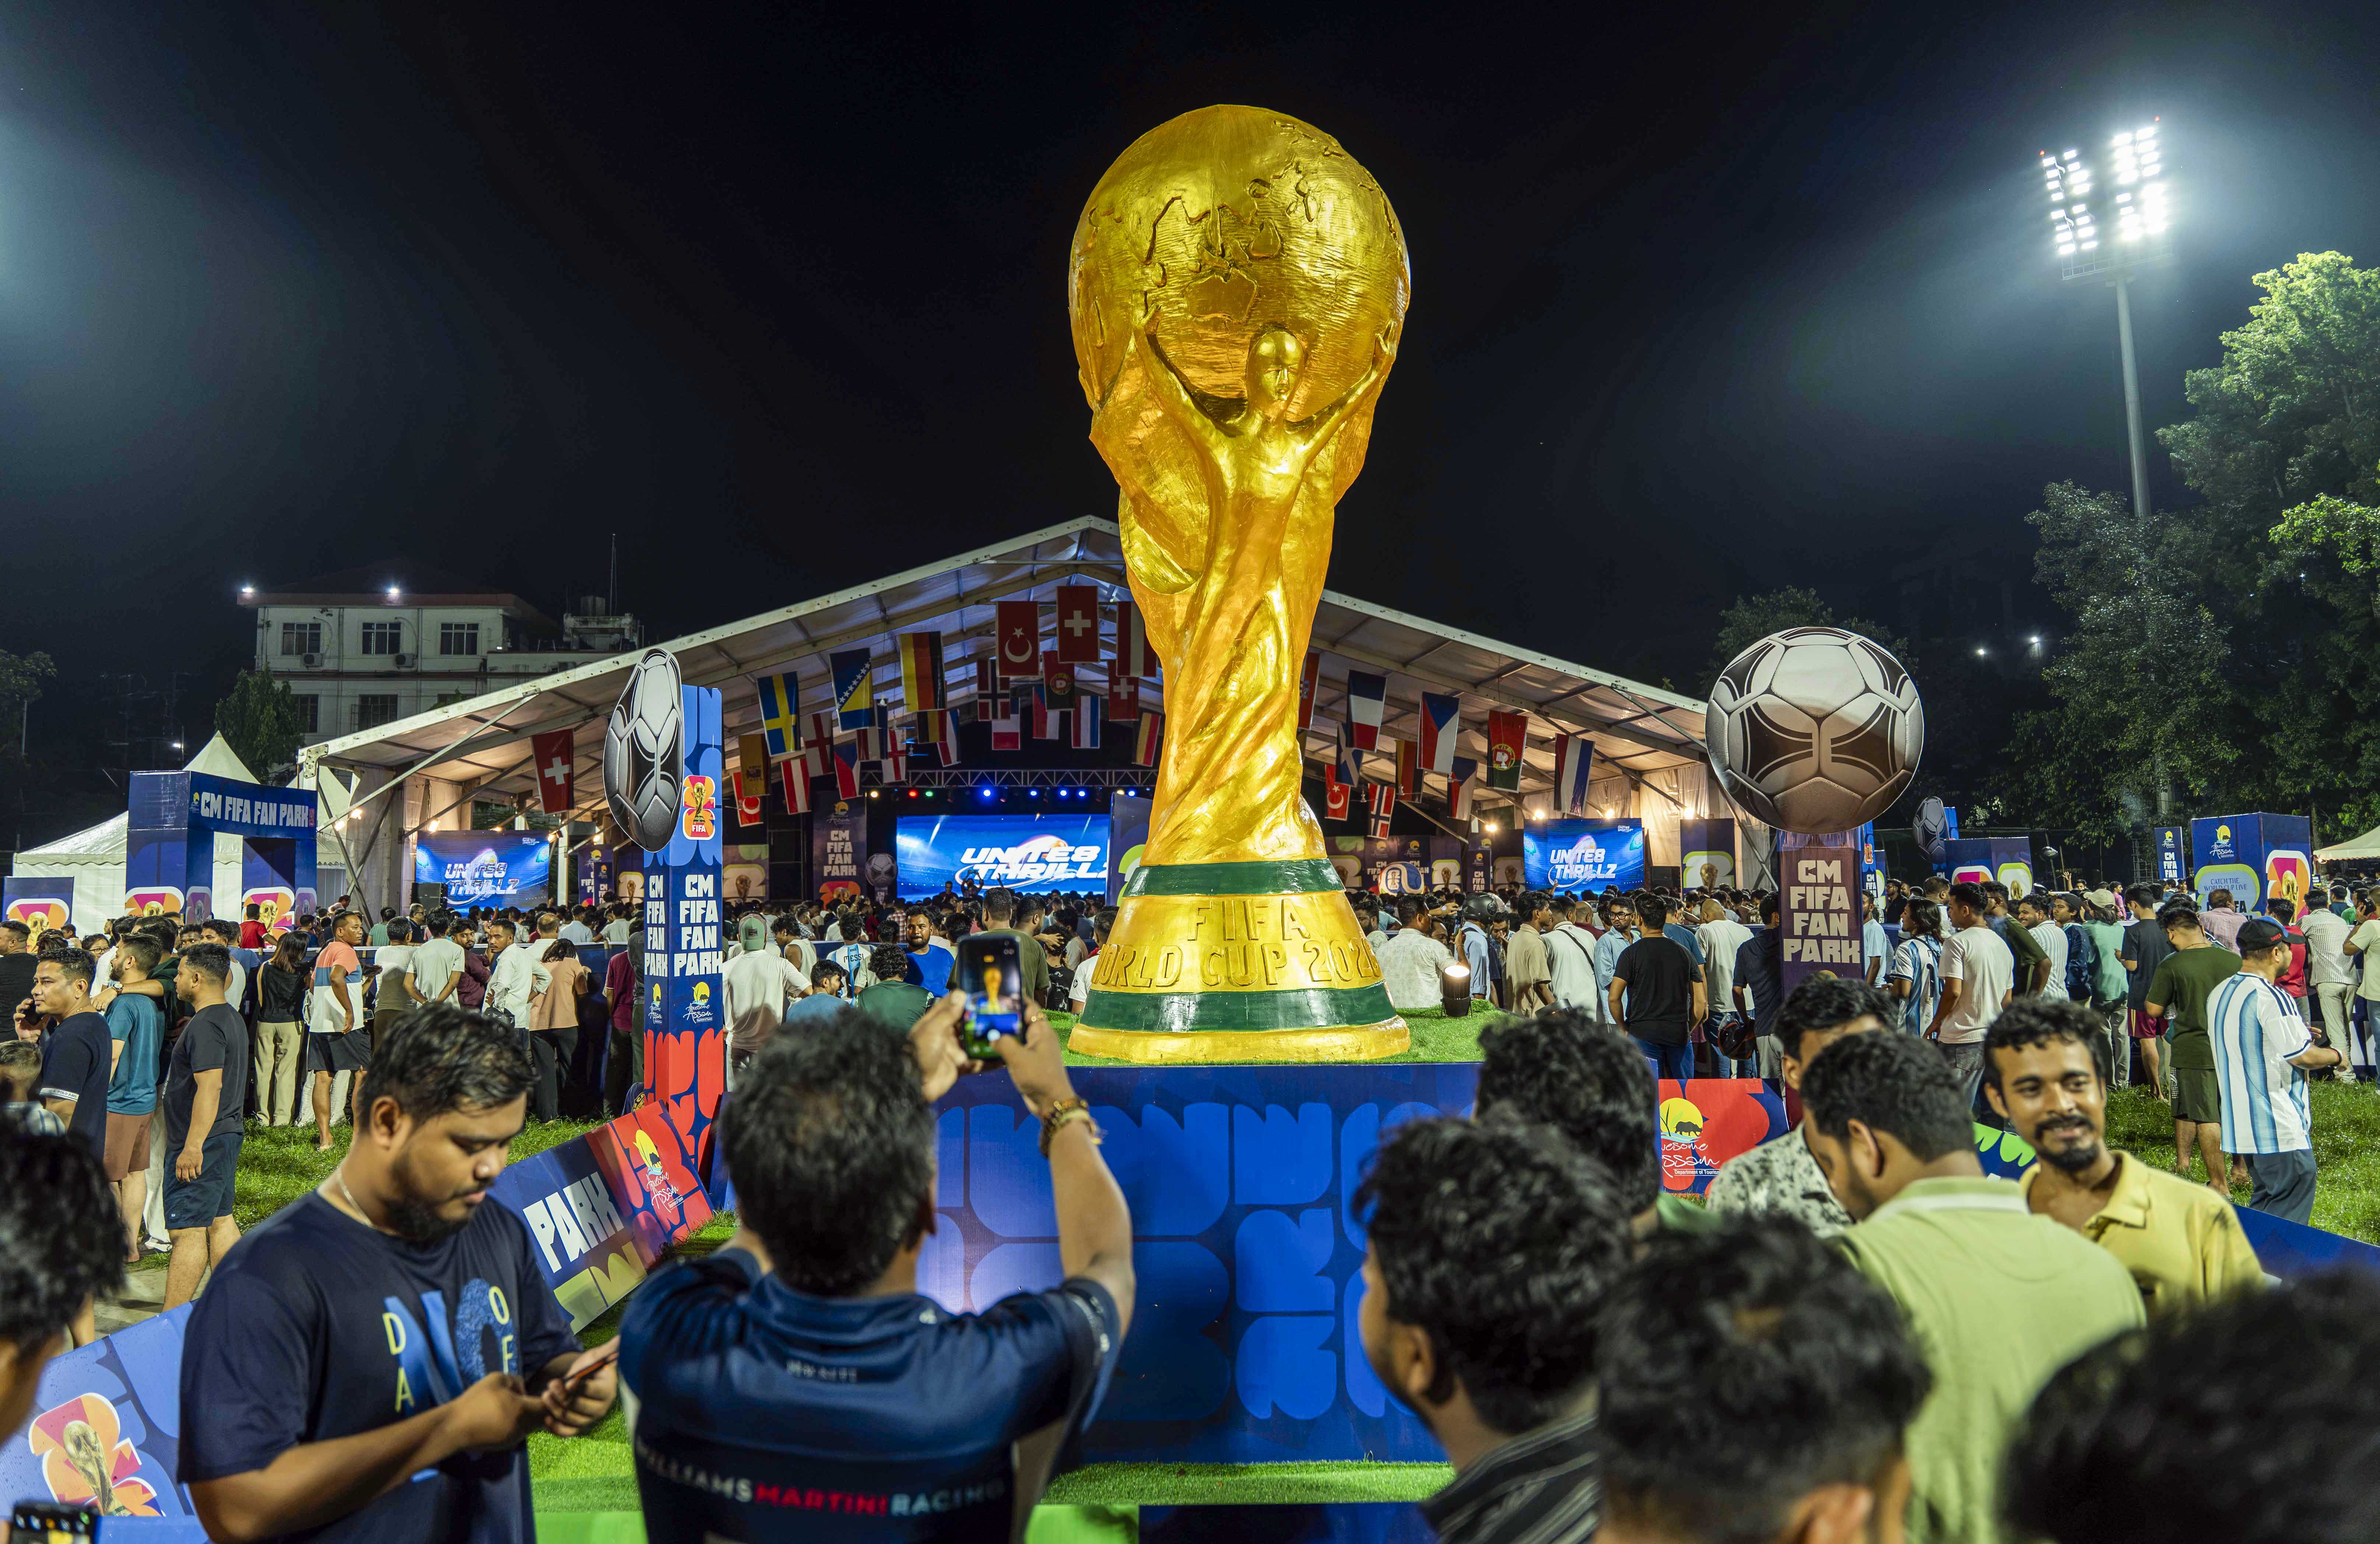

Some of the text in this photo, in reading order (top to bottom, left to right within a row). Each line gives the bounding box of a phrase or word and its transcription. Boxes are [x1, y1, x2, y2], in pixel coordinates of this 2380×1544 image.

[201, 792, 222, 819] CM
[225, 796, 251, 824] FIFA
[254, 801, 277, 825] FAN
[279, 804, 308, 827] PARK
[831, 830, 849, 841] CM
[827, 842, 853, 853] FIFA
[828, 853, 852, 864] FAN
[2165, 852, 2175, 860] CM
[824, 865, 857, 876] PARK
[1555, 864, 1617, 878] THRILLZ
[1798, 860, 1841, 883] CM
[2165, 870, 2177, 878] FAN
[649, 875, 663, 898] CM
[685, 874, 714, 898] CM
[1790, 887, 1850, 910] FIFA
[647, 901, 665, 924] FIFA
[680, 900, 719, 924] FIFA
[1187, 899, 1310, 941] FIFA
[1794, 913, 1848, 937] FAN
[647, 927, 664, 950] FAN
[681, 925, 717, 950] FAN
[844, 953, 864, 962] MESSI
[1200, 943, 1287, 987] CUP
[1303, 937, 1381, 982] 2026
[1783, 939, 1860, 964] PARK
[644, 953, 668, 977] PARK
[674, 951, 723, 977] PARK
[683, 1008, 713, 1024] Assam
[685, 1003, 709, 1011] Awesome
[1662, 1143, 1708, 1151] wesome
[1662, 1155, 1720, 1172] ssam
[652, 1183, 678, 1213] Assam
[523, 1172, 624, 1273] PARK
[755, 1482, 888, 1518] MARTINI
